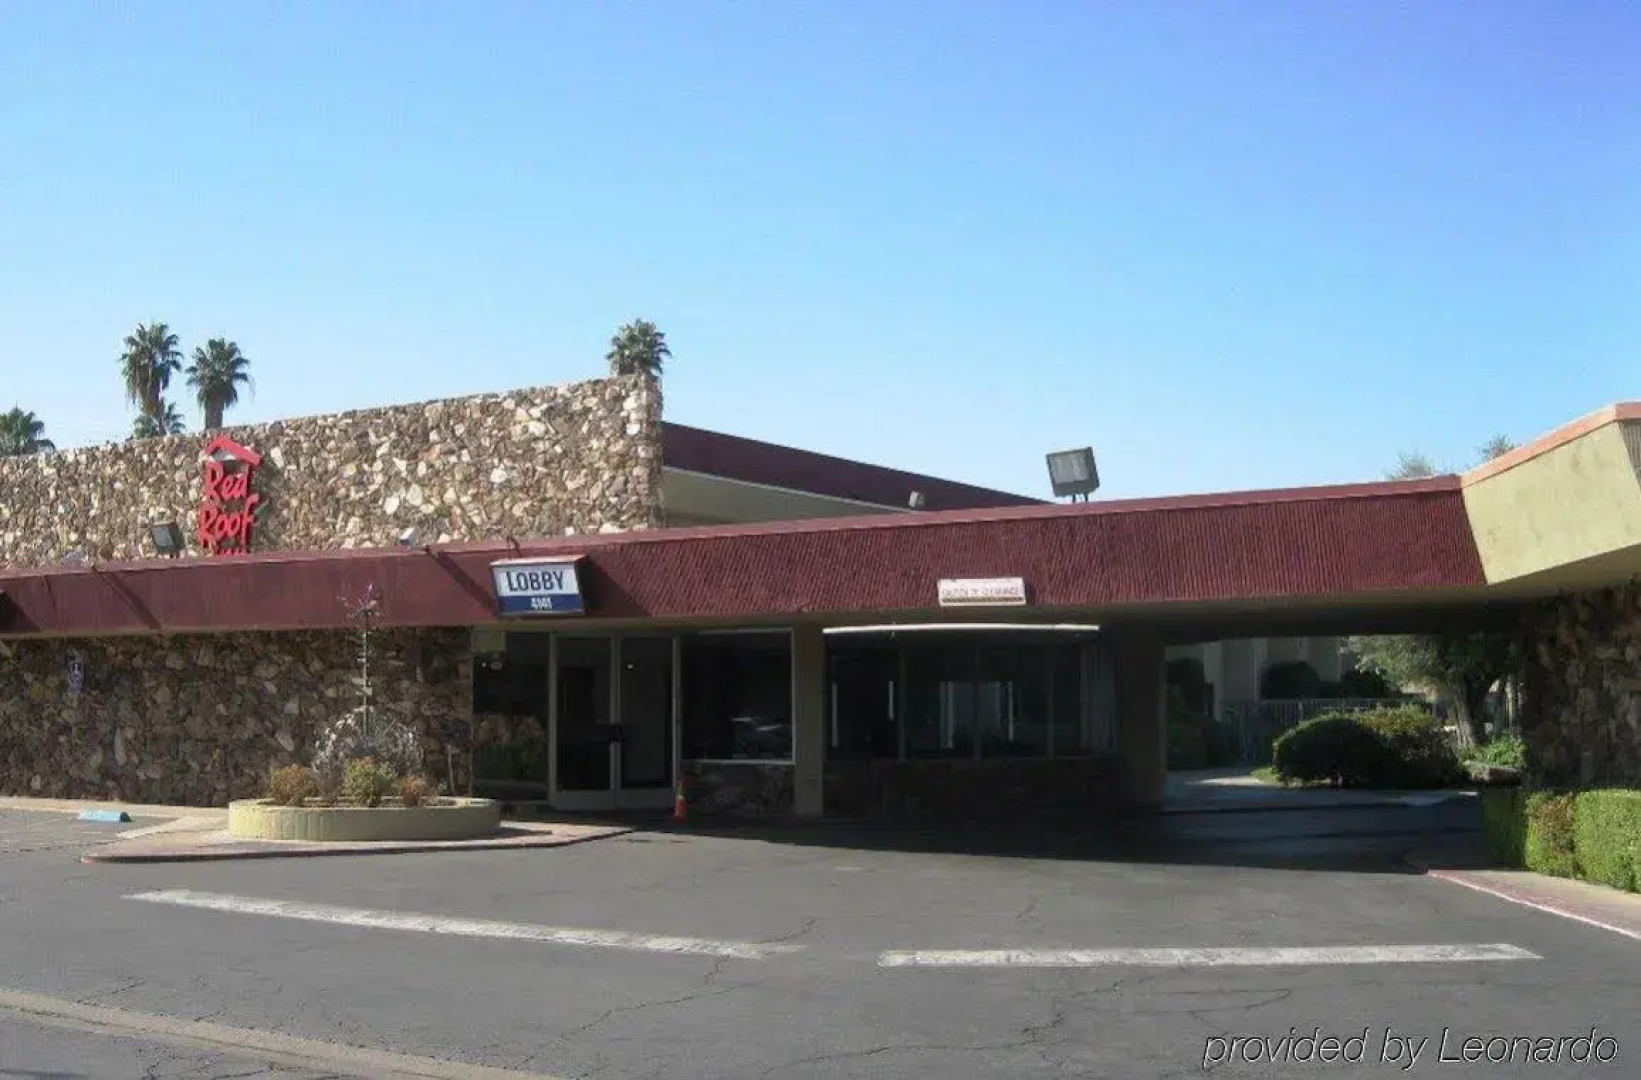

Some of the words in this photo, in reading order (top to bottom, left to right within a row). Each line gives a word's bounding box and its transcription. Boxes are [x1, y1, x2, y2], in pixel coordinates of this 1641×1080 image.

[204, 462, 250, 500] Red
[198, 494, 259, 547] Roof
[506, 571, 563, 591] LOBBY
